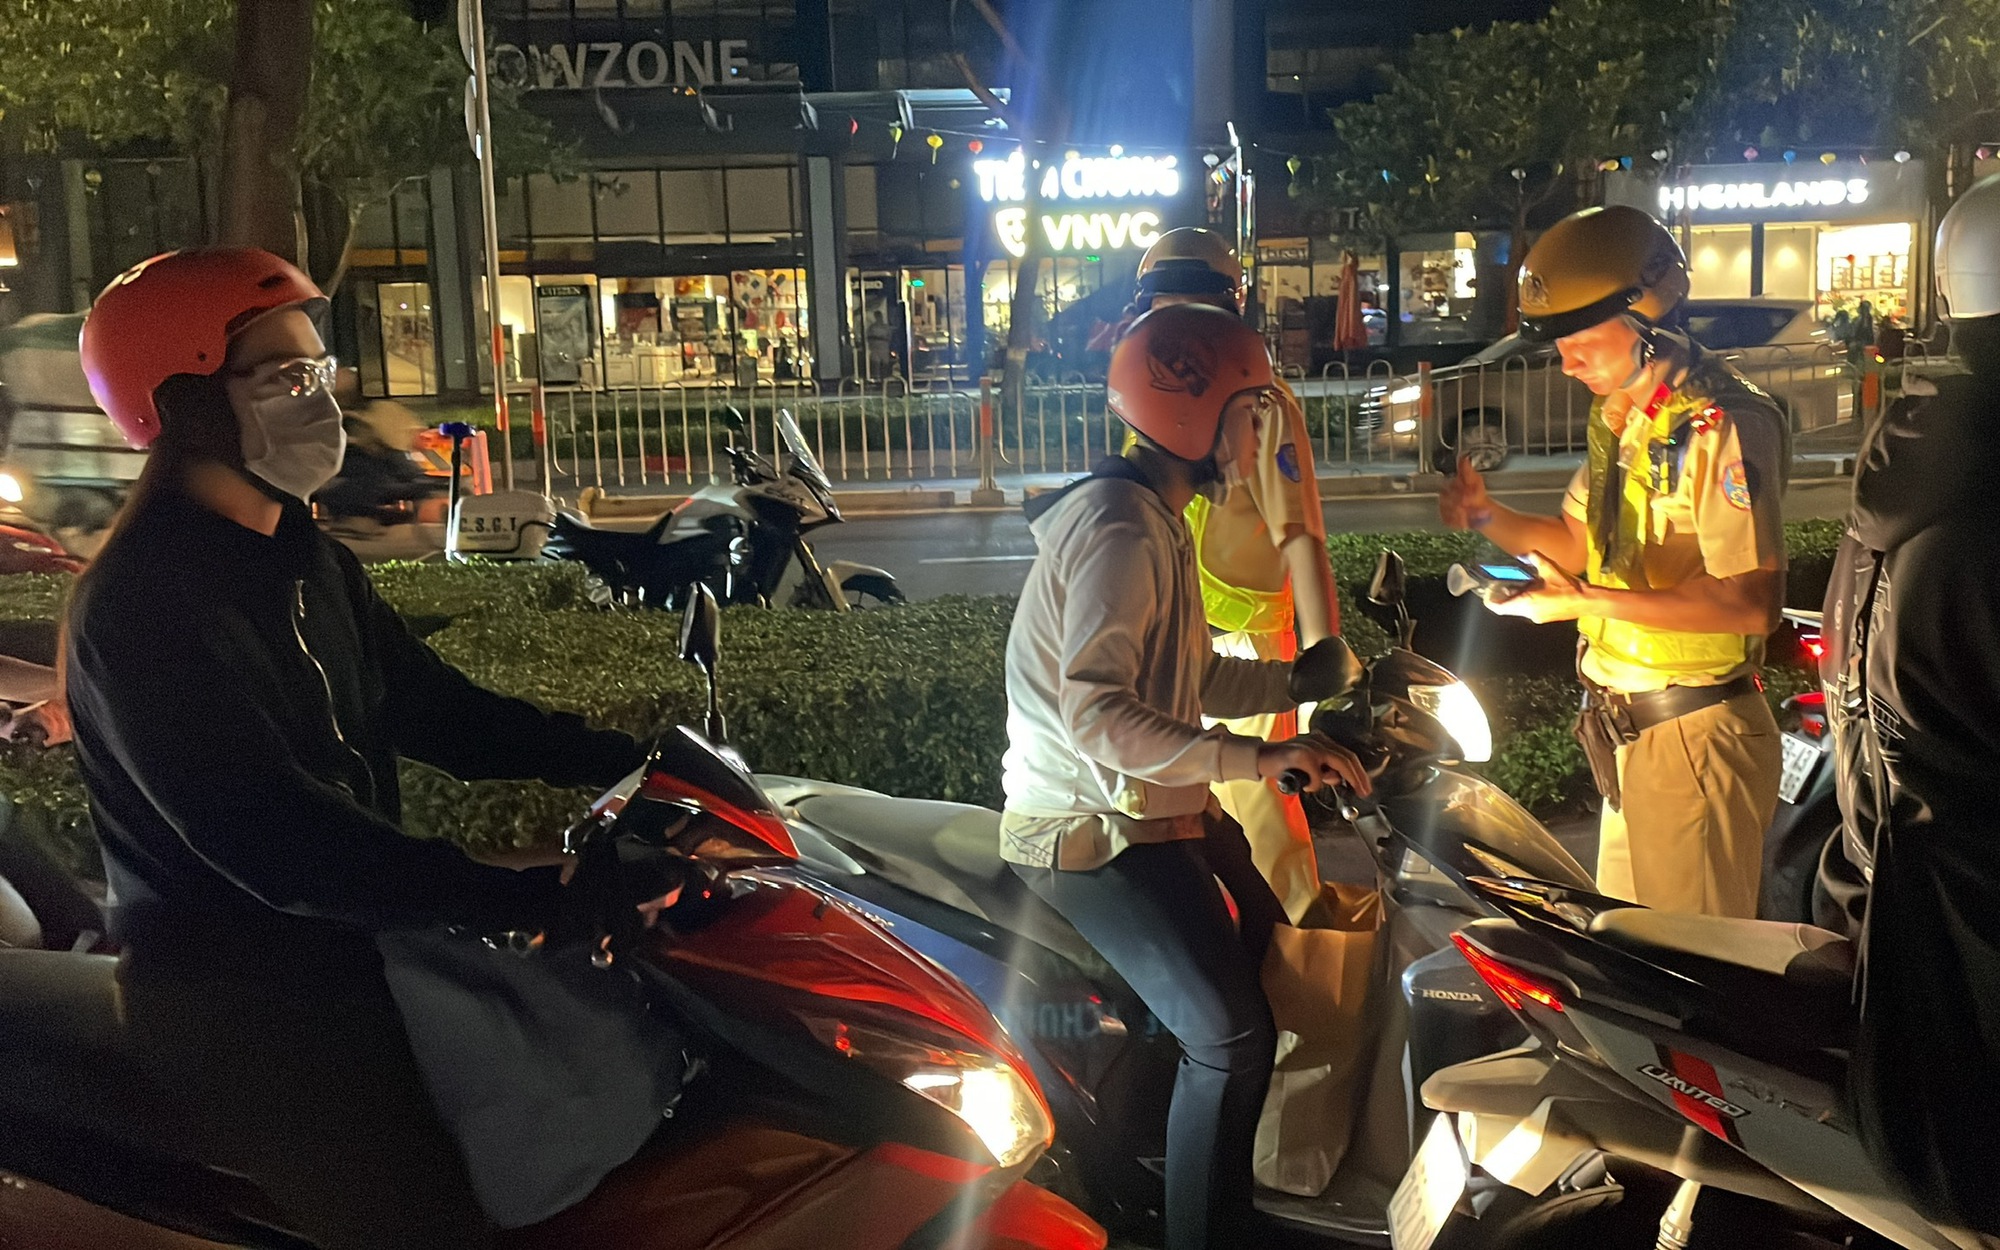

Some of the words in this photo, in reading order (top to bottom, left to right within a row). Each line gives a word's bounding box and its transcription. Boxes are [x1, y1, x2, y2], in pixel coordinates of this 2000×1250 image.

[487, 39, 751, 90] OWZONE
[1658, 178, 1869, 211] HIGHLANDS
[1042, 211, 1160, 251] VNVC
[1423, 989, 1484, 1002] HONDA
